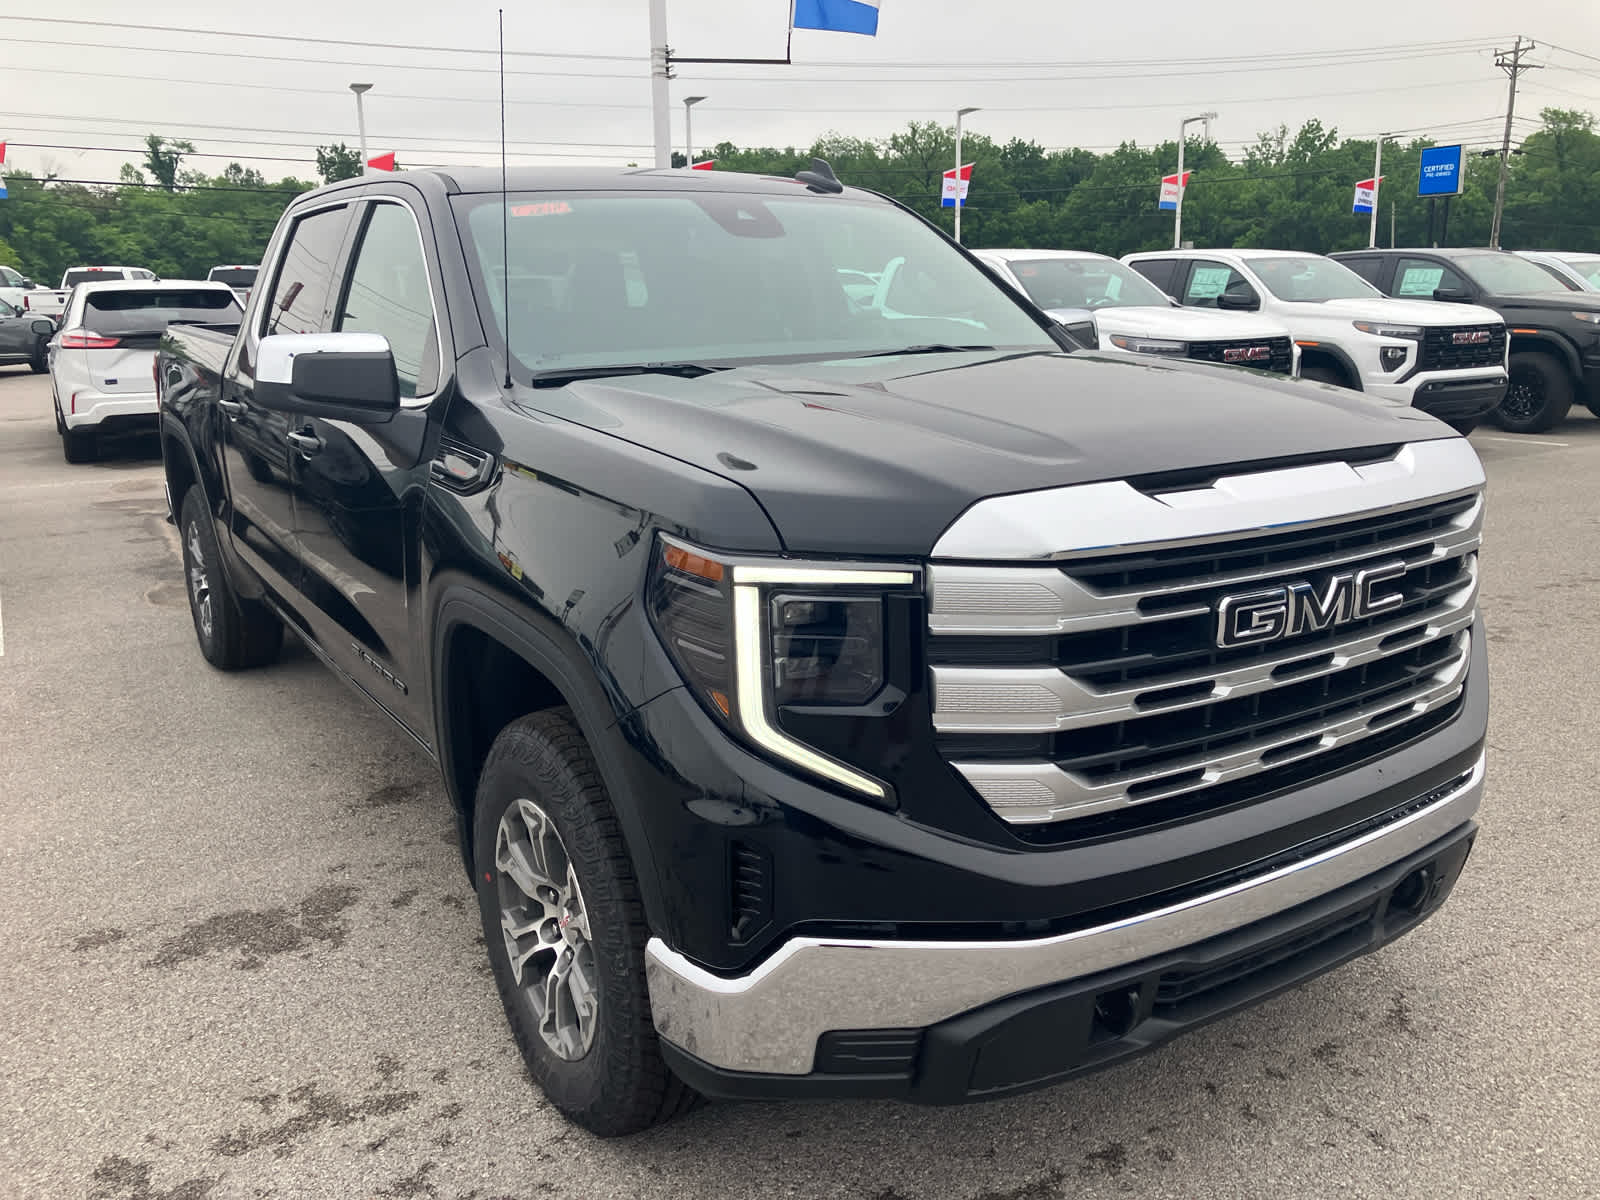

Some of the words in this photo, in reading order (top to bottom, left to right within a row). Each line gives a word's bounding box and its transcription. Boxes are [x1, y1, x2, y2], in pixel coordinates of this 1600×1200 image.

[1452, 331, 1490, 344] GMC
[1223, 346, 1270, 362] GMC
[1216, 560, 1407, 648] GMC
